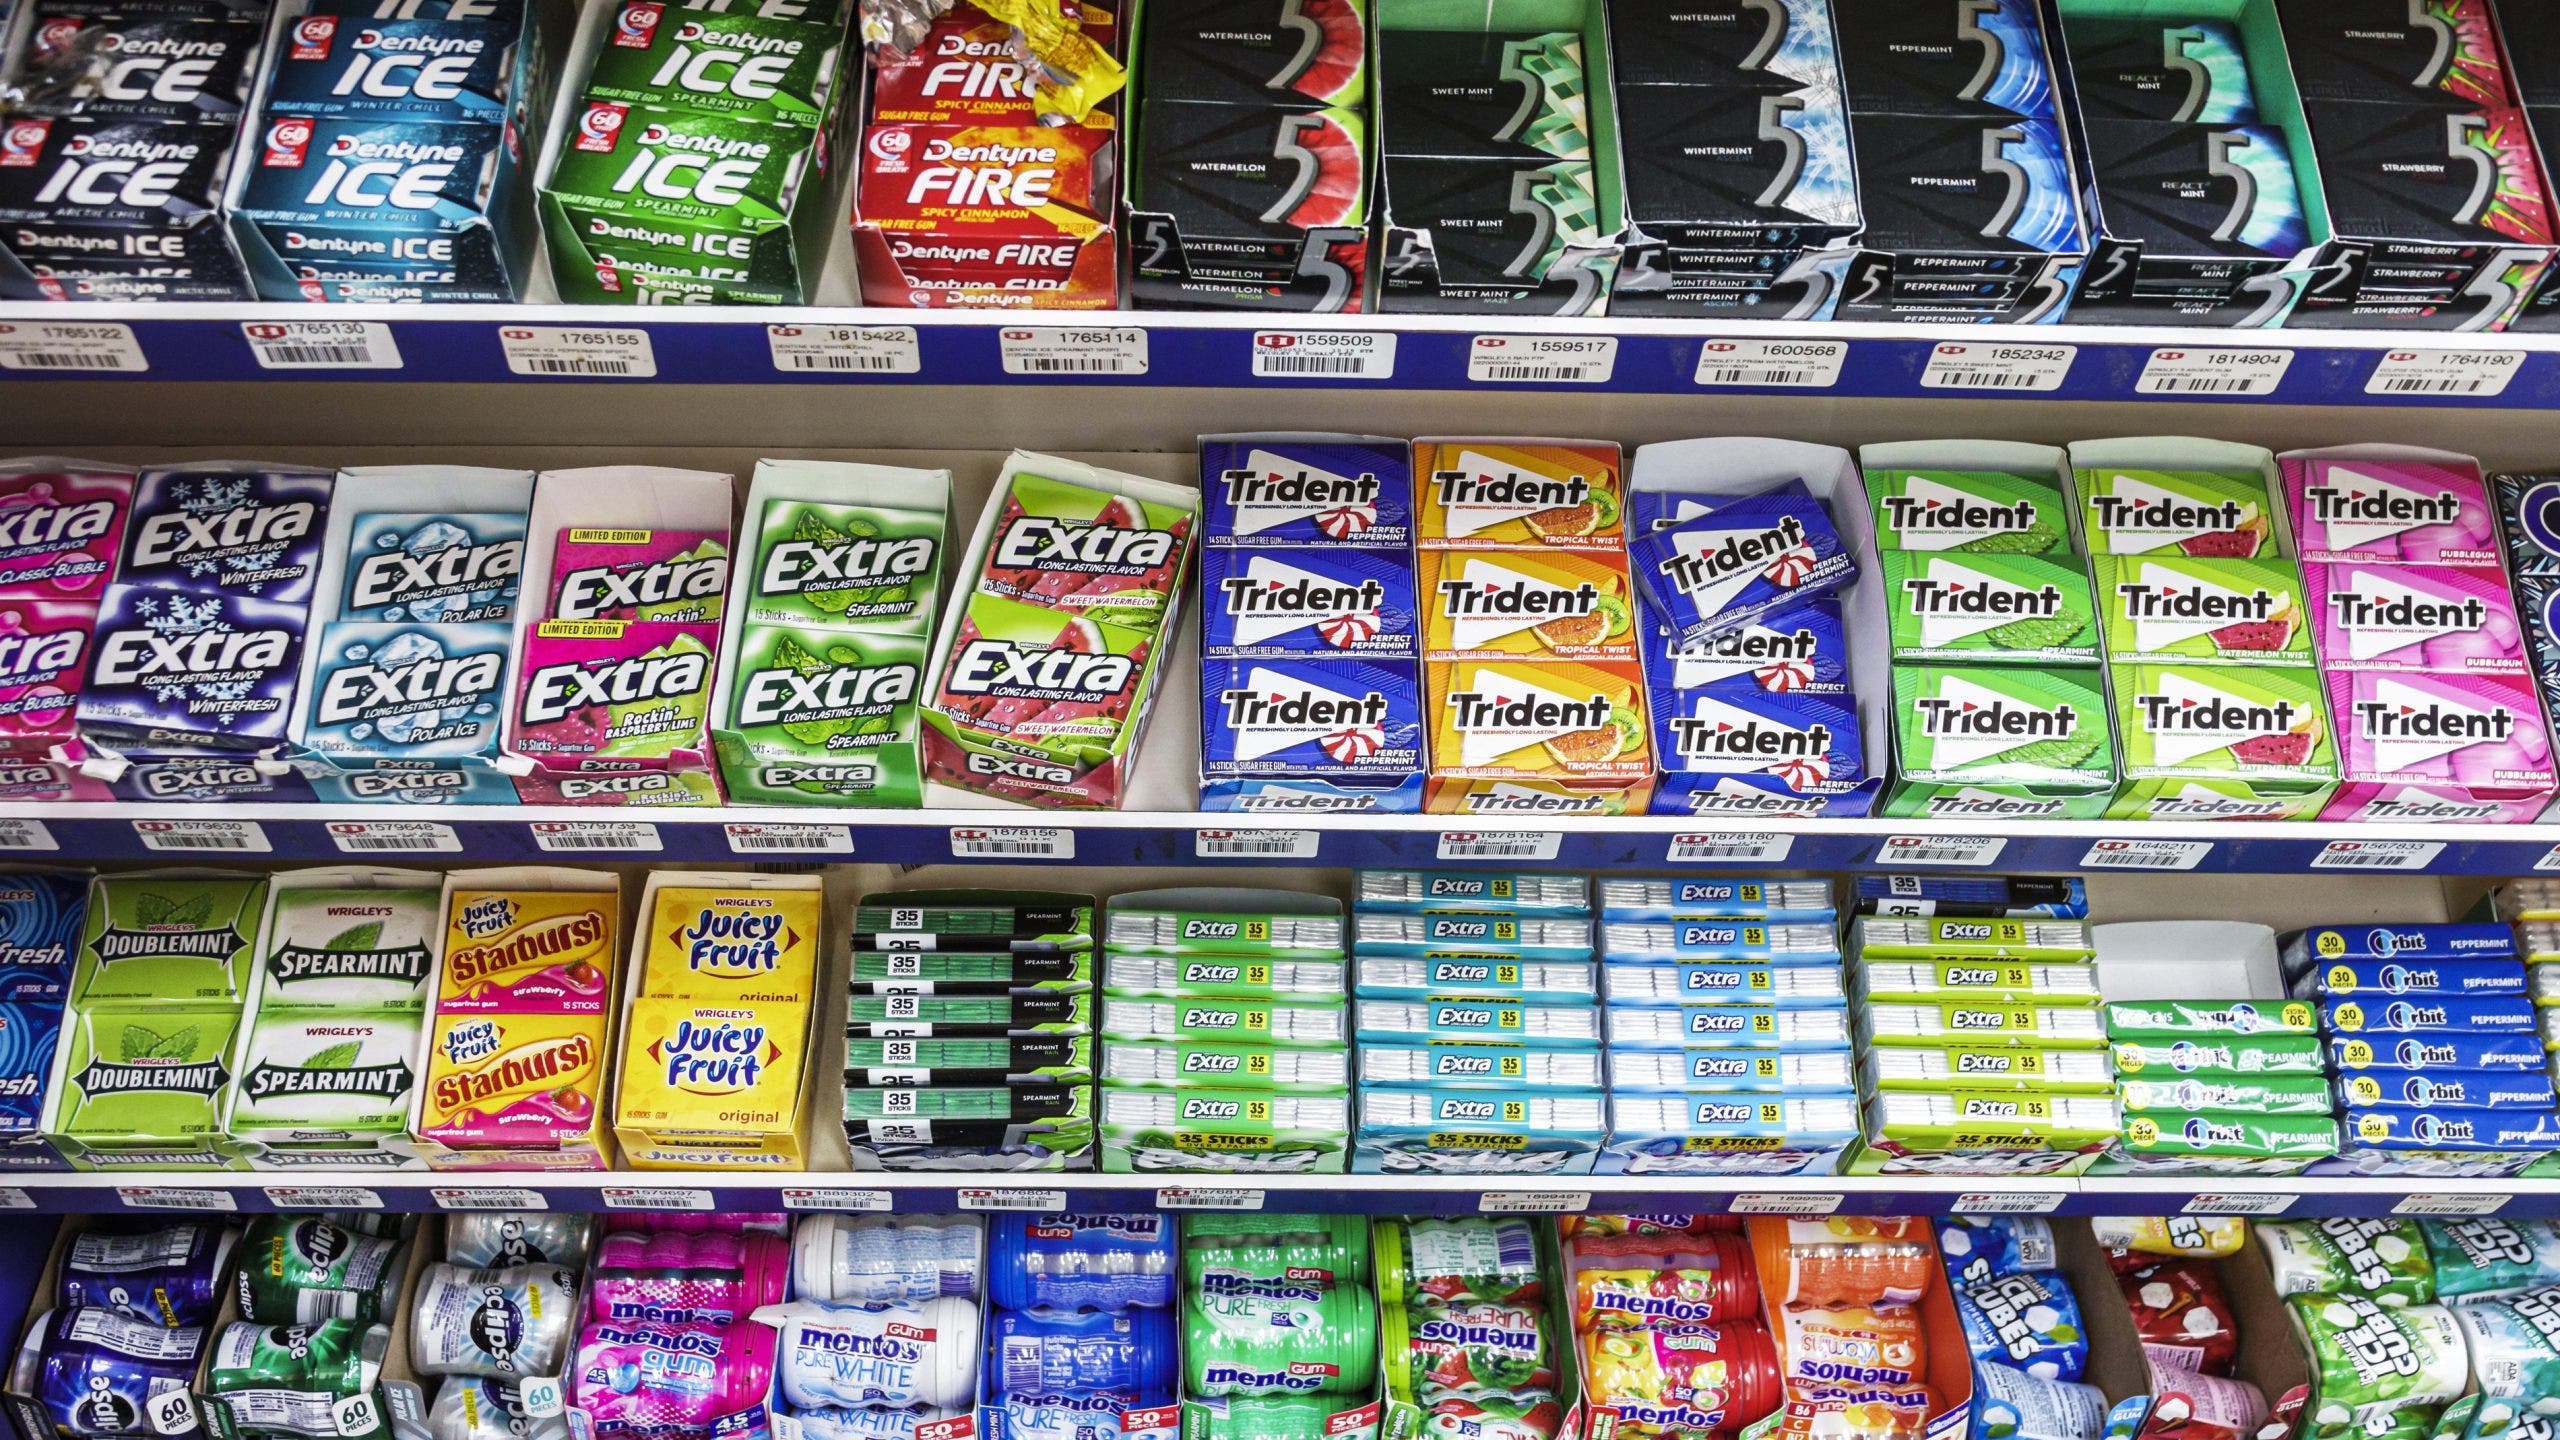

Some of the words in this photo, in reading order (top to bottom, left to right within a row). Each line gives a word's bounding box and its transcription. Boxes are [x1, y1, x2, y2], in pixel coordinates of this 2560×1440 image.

[353, 30, 483, 55] Dentyne
[674, 21, 802, 54] Dentyne
[332, 56, 476, 99] ICE
[650, 44, 794, 100] ICE
[351, 102, 400, 112] WINTER
[406, 103, 441, 112] CHILL
[672, 92, 754, 111] SPEARMINT
[61, 136, 199, 162] Dentyne
[327, 136, 463, 162] Dentyne
[638, 123, 770, 158] Dentyne
[923, 140, 1056, 164] Dentyne
[1684, 147, 1752, 155] WINTERMINT
[1754, 96, 1804, 207] 5
[612, 148, 761, 205] ICE
[1191, 163, 1266, 173] WATERMELON
[1260, 115, 1324, 223] 5
[2382, 163, 2445, 172] STRAWBERRY
[2447, 114, 2497, 223] 5
[35, 161, 190, 205] ICE
[305, 160, 455, 208] ICE
[907, 167, 1055, 207] FIRE
[1911, 178, 1976, 187] PEPPERMINT
[1980, 128, 2023, 237] 5
[2180, 189, 2205, 198] MINT
[2208, 132, 2255, 241] 5
[922, 208, 958, 217] SPICY
[960, 209, 1029, 218] CINNAMON
[1440, 220, 1475, 228] SWEET
[1478, 220, 1503, 228] MINT
[1503, 171, 1555, 277] 5
[590, 219, 686, 245] Dentyne
[692, 234, 751, 259] ICE
[1686, 229, 1761, 239] WINTERMINT
[286, 233, 386, 255] Dentyne
[392, 238, 452, 260] ICE
[892, 241, 989, 262] Dentyne
[996, 245, 1075, 266] FIRE
[2387, 245, 2459, 256] STRAWBERRY
[1914, 258, 1987, 268] PEPPERMINT
[1182, 284, 1262, 294] WATERMELON
[1440, 290, 1475, 299] SWEET
[1476, 291, 1509, 300] MINT
[43, 327, 122, 340] 1765122
[285, 323, 364, 335] 1765130
[561, 333, 638, 345] 1765155
[829, 331, 905, 341] 1815422
[1059, 333, 1136, 343] 1765114
[1296, 335, 1373, 347] 1559509
[1531, 341, 1606, 353] 1559517
[1761, 345, 1836, 356] 1600568
[1991, 349, 2065, 360] 1852342
[2207, 354, 2281, 364] 1814904
[2440, 355, 2513, 366] 1764190
[2310, 489, 2458, 521] Trident
[997, 517, 1173, 568] Extra
[1347, 532, 1406, 540] PEPPERMINT
[1664, 516, 1802, 587] Trident
[1812, 553, 1847, 571] PERFECT
[763, 540, 932, 593] Extra
[1798, 561, 1850, 584] PEPPERMINT
[805, 582, 829, 592] LONG
[831, 579, 868, 589] LASTING
[872, 575, 910, 587] FLAVOR
[1226, 579, 1382, 612] Trident
[847, 602, 914, 616] SPEARMINT
[1442, 582, 1596, 614] Trident
[1908, 581, 2059, 614] Trident
[2121, 585, 2272, 618] Trident
[2333, 594, 2483, 628] Trident
[543, 625, 580, 635] LIMITED
[583, 625, 618, 635] EDITION
[1351, 641, 1409, 649] PEPPERMINT
[1555, 646, 1603, 654] TROPICAL
[1606, 646, 1631, 654] TWIST
[2217, 650, 2276, 659] WATERMELON
[2278, 651, 2308, 659] TWIST
[94, 630, 289, 685] Extra
[951, 641, 1132, 693] Extra
[2467, 659, 2523, 667] BUBBLEGUM
[317, 654, 500, 723] Extra
[526, 655, 704, 723] Extra
[189, 699, 278, 713] WINTERFRESH
[1226, 692, 1385, 725] Trident
[1452, 694, 1610, 727] Trident
[1920, 700, 2075, 735] Trident
[2139, 697, 2293, 731] Trident
[409, 725, 450, 741] POLAR
[452, 723, 476, 737] ICE
[605, 720, 668, 739] RASPBERRY
[670, 717, 696, 730] LIME
[1018, 724, 1049, 734] SWEET
[1052, 725, 1112, 735] WATERMELON
[2357, 703, 2511, 738] Trident
[1675, 720, 1829, 755] Trident
[2494, 771, 2551, 779] BUBBLEGUM
[174, 822, 242, 831] 1579630
[366, 822, 433, 831] 1579648
[327, 907, 392, 916] WRIGLEY'S
[715, 898, 773, 907] WRIGLEY'S
[687, 910, 783, 942] Juicy
[1941, 923, 1992, 939] Extra
[2002, 925, 2015, 934] 35
[103, 931, 231, 955] DOUBLEMINT
[453, 917, 601, 981] Starburst
[2323, 937, 2338, 947] 30
[279, 950, 423, 976] SPEARMINT
[690, 940, 779, 970] Fruit
[563, 1002, 571, 1010] 15
[572, 1002, 599, 1010] STICKS
[306, 1027, 373, 1036] WRIGLEY'S
[665, 1022, 764, 1054] Juicy
[87, 1064, 219, 1090] DOUBLEMINT
[253, 1069, 402, 1093] SPEARMINT
[437, 1039, 590, 1109] Starburst
[669, 1054, 760, 1086] Fruit
[889, 1094, 911, 1104] 35
[1184, 1101, 1239, 1118] Extra
[1250, 1103, 1264, 1114] 35
[1441, 1101, 1495, 1119] Extra
[1506, 1103, 1520, 1114] 35
[719, 1111, 778, 1123] original
[1698, 1103, 1751, 1121] Extra
[1762, 1105, 1776, 1116] 35
[1181, 1134, 1204, 1144] 35
[1208, 1134, 1268, 1145] STICKS
[1289, 1268, 1321, 1280] GUM
[1203, 1295, 1255, 1316] PURE
[1257, 1300, 1291, 1310] FRESH
[1595, 1293, 1711, 1319] mentos
[600, 1328, 721, 1354] mentos
[800, 1331, 920, 1361] mentos
[1423, 1323, 1537, 1349] mentos
[643, 1351, 714, 1376] gum
[836, 1358, 912, 1389] WHITE
[1207, 1367, 1322, 1389] mentos
[161, 1400, 187, 1417] 60
[1126, 1412, 1160, 1425] 50
[1795, 1405, 1810, 1415] B6
[165, 1411, 193, 1431] PIECES
